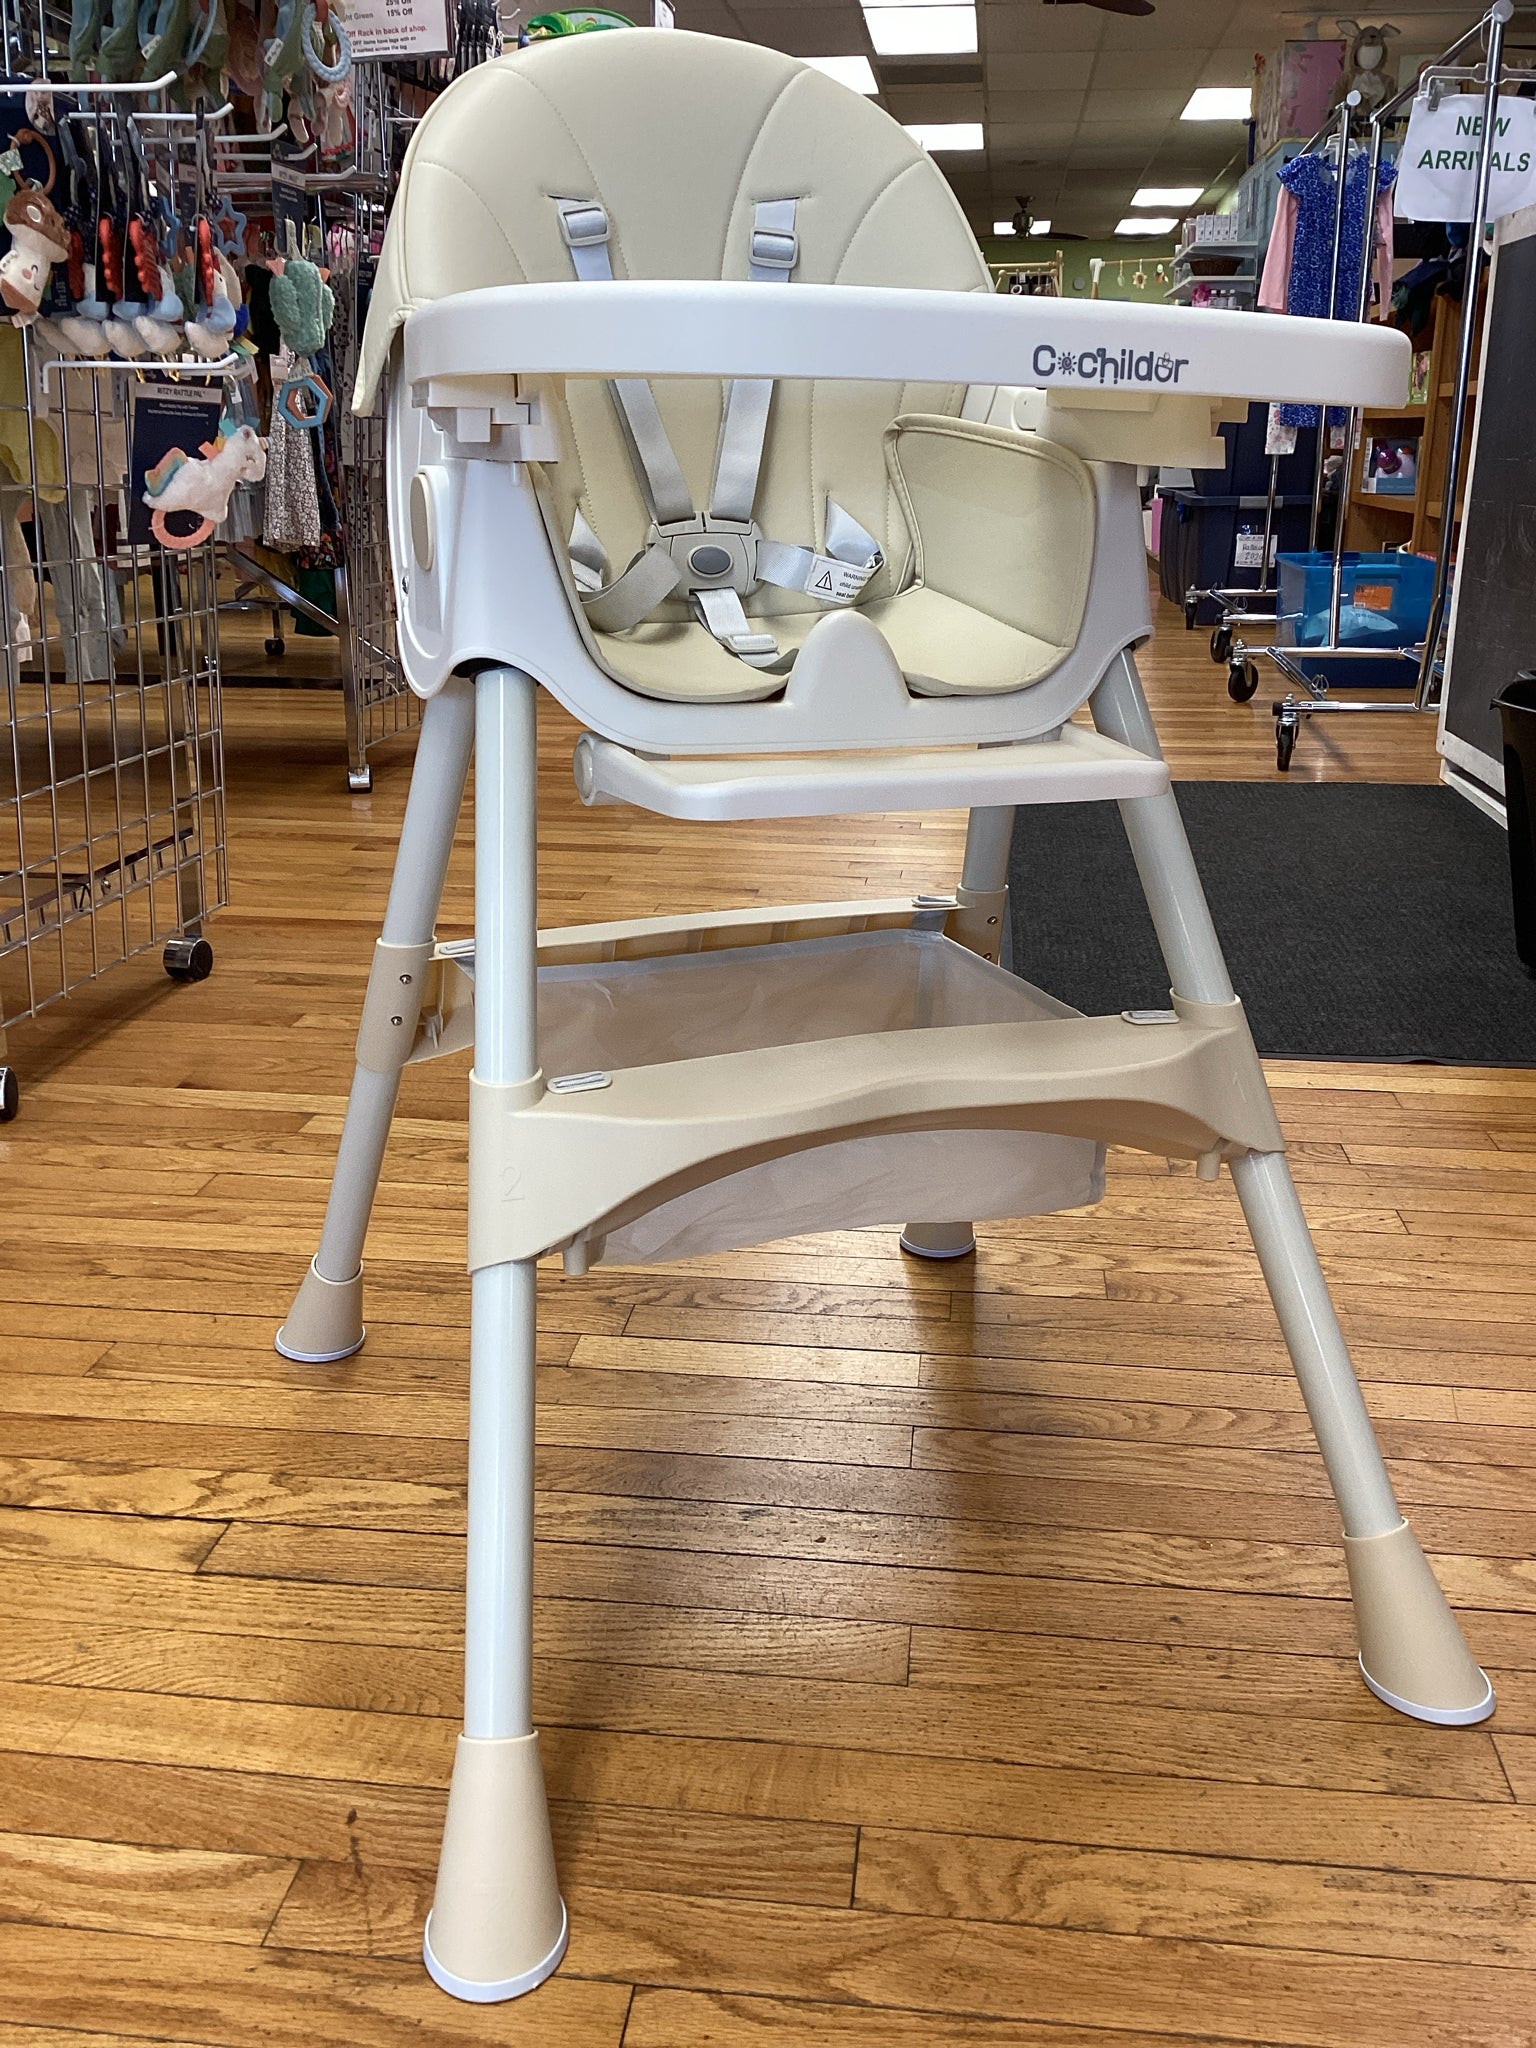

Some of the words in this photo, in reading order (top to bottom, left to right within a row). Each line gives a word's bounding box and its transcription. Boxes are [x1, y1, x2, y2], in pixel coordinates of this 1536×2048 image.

[358, 28, 374, 37] Rack
[384, 26, 398, 35] back
[410, 25, 426, 34] shop.
[1417, 149, 1531, 172] ARRIALS
